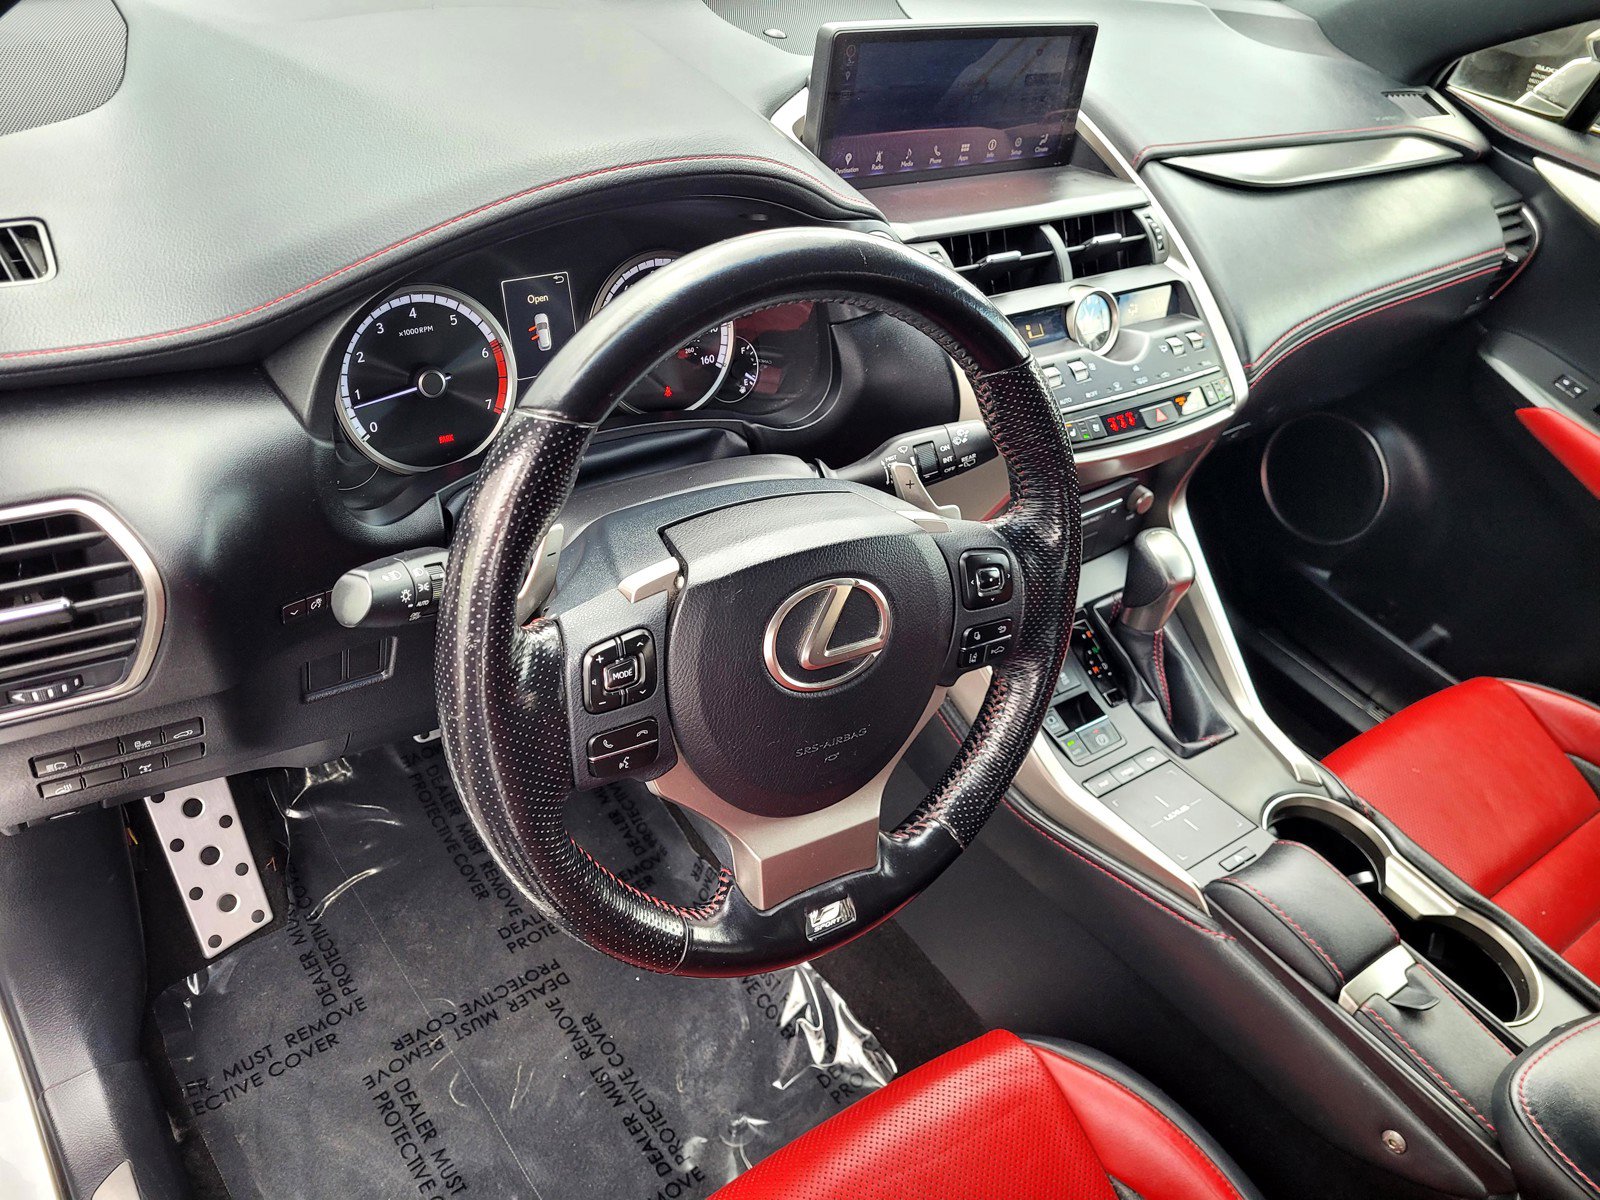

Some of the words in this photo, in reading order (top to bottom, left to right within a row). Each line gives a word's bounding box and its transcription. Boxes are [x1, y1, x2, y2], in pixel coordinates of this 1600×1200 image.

[835, 166, 859, 175] Destination
[408, 307, 417, 319] 4
[527, 294, 549, 304] Open
[376, 323, 385, 334] 3
[449, 315, 458, 326] 5
[356, 351, 366, 363] 2
[481, 348, 489, 358] 6
[700, 354, 715, 365] 160
[354, 389, 361, 400] 1
[485, 399, 492, 409] 7
[369, 422, 378, 433] 0
[940, 444, 951, 452] ON
[942, 455, 954, 464] INT
[961, 453, 977, 462] REAR
[612, 668, 633, 680] MODE
[409, 773, 460, 854] PROTECTIVE
[453, 854, 490, 901] COVER
[456, 821, 486, 856] MUST
[480, 860, 523, 918] REMOVE
[299, 950, 338, 1008] DEALER
[459, 958, 561, 1017] PROTECTIVE
[505, 971, 570, 1014] DEALER
[222, 1044, 274, 1081] MUST
[284, 996, 368, 1048] REMOVE
[390, 1012, 457, 1051] COVER
[453, 1009, 499, 1042] MUST
[545, 997, 595, 1061] REMOVE
[581, 1012, 624, 1067] COVER
[268, 1032, 340, 1077] COVER
[362, 1039, 445, 1090] REMOVE
[590, 1066, 627, 1108] MUST
[618, 1067, 691, 1166] PROTECTIVE
[372, 1090, 437, 1194] PROTECTIVE
[393, 1077, 438, 1144] DEALER
[430, 1147, 468, 1196] MUST
[622, 1112, 672, 1177] DEALER
